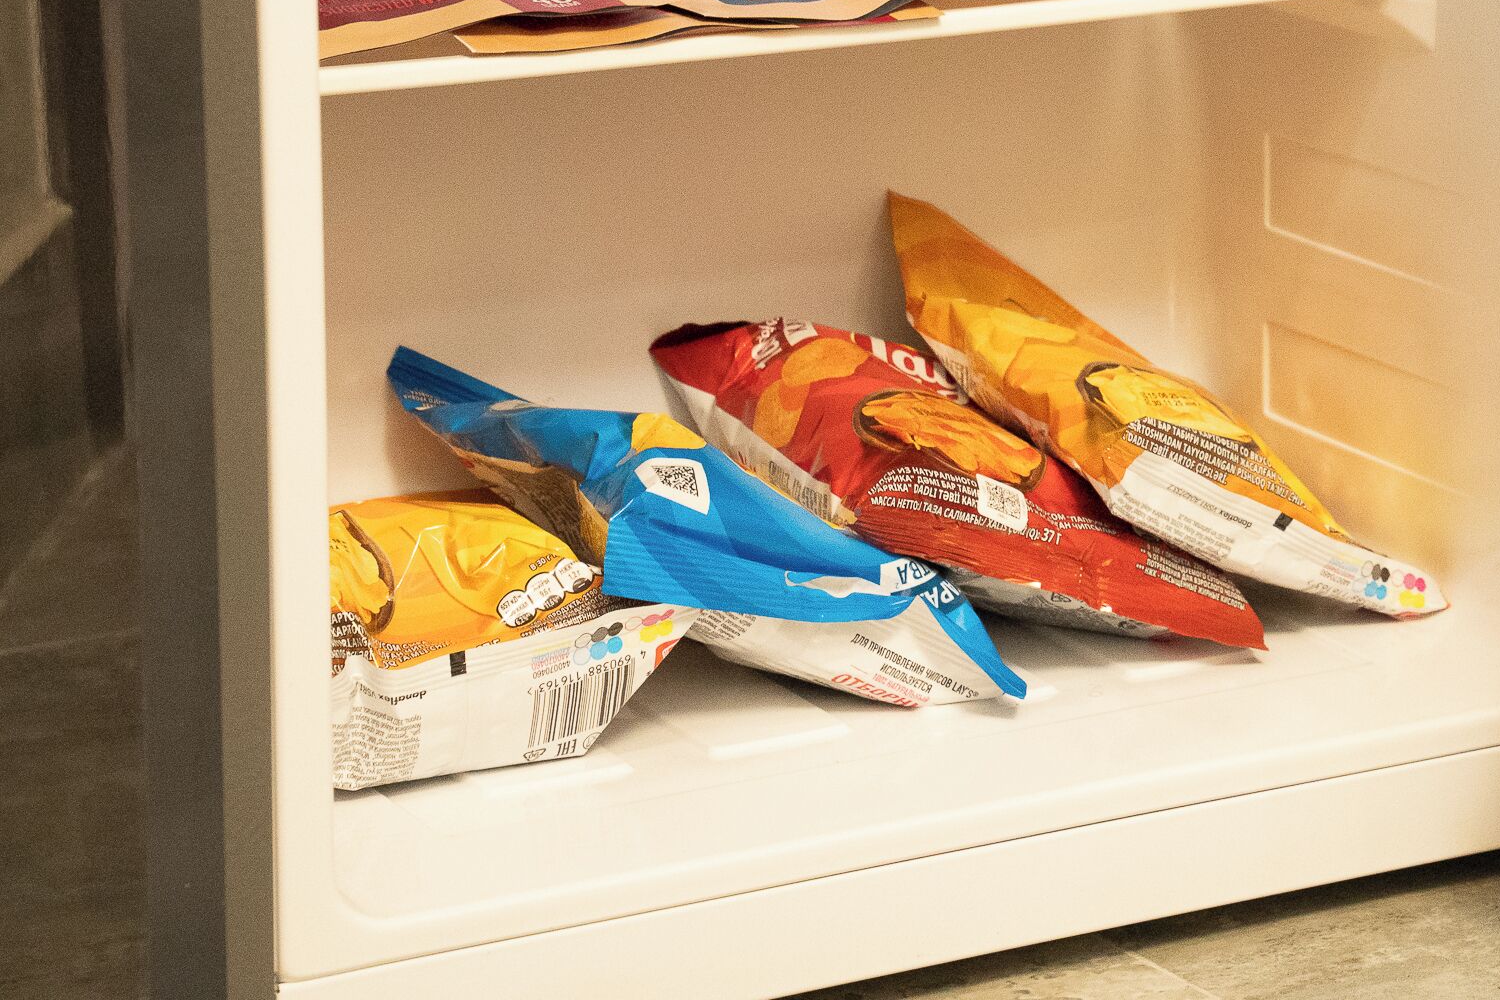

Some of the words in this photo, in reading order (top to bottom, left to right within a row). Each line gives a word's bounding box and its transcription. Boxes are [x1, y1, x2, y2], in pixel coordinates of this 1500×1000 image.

[1168, 449, 1196, 472] KARTOF
[914, 484, 937, 498] DADLI
[871, 496, 896, 508] МАССА
[1041, 526, 1054, 543] 37
[1218, 508, 1254, 531] danaflex
[537, 557, 547, 569] 30
[588, 654, 632, 677] 690388
[851, 633, 870, 649] ДЛЯ
[868, 641, 926, 675] ПРИГОТОВЛЕНИЯ
[925, 668, 953, 689] ЧИПСОВ
[538, 672, 581, 693] 116163
[880, 663, 933, 694] ИСПОЛЬЗУЕТСЯ
[378, 690, 427, 706] danaflex
